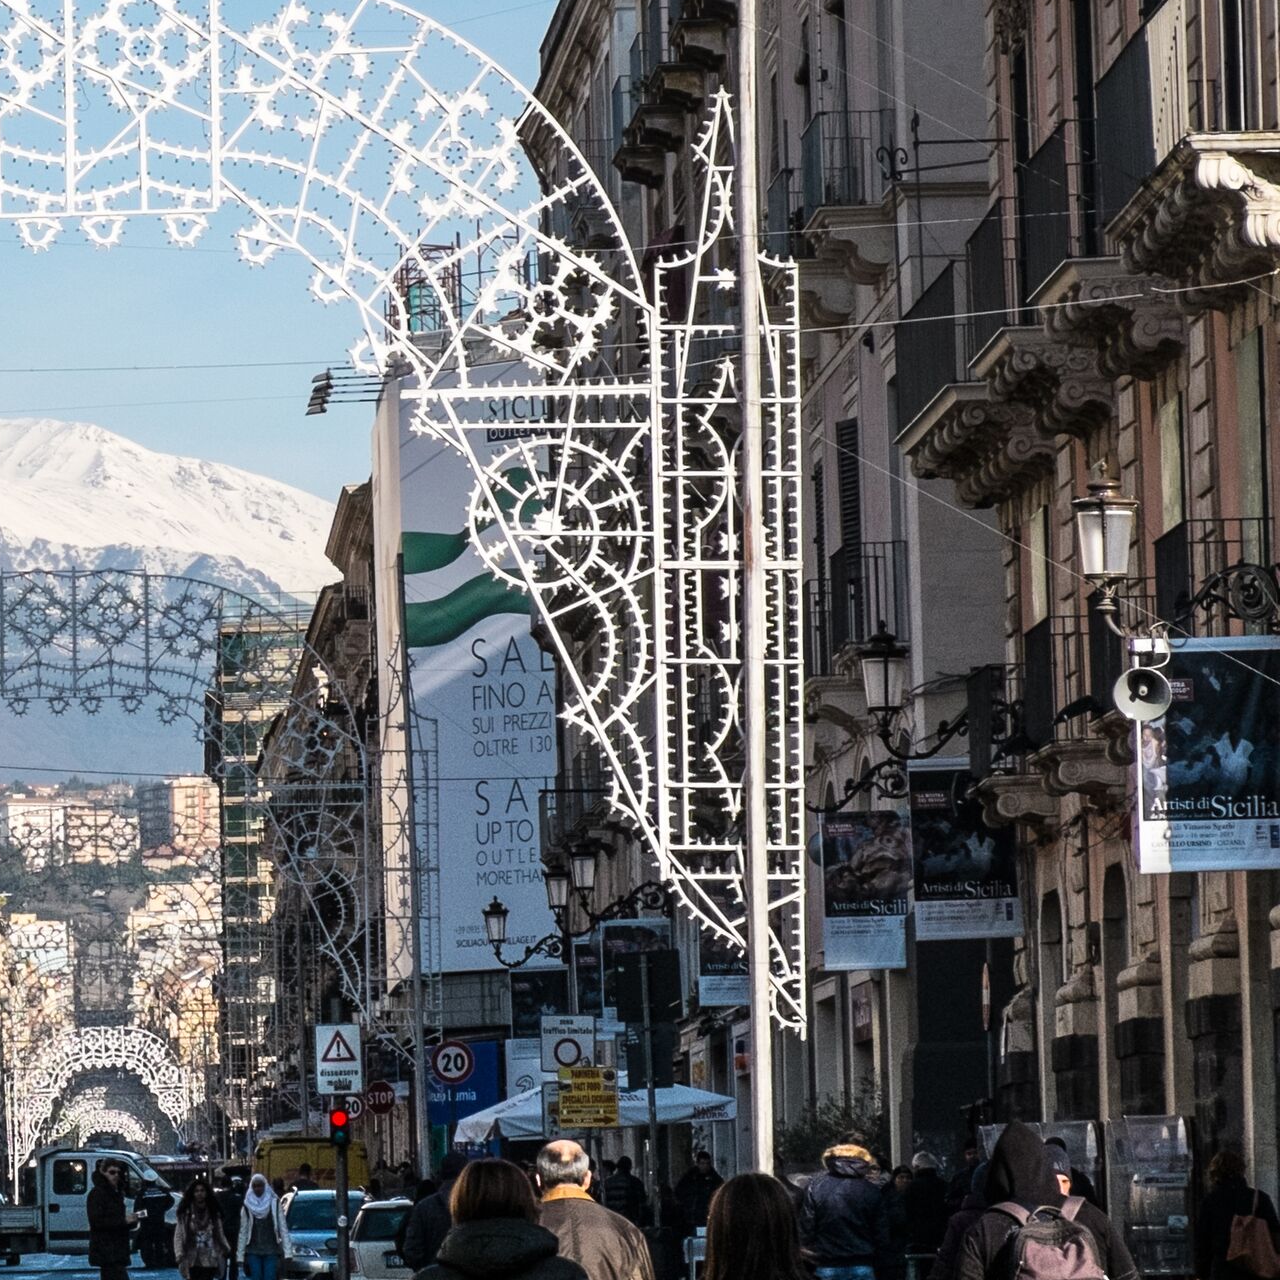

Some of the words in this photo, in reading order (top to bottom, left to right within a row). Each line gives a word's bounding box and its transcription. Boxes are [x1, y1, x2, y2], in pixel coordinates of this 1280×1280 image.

[472, 682, 525, 711] FINO
[536, 680, 553, 705] A
[472, 717, 494, 735] SUI
[503, 711, 552, 732] PREZZI
[473, 738, 518, 757] OLTRE
[530, 735, 552, 753] 130
[1150, 797, 1195, 811] Artisti
[1197, 796, 1210, 810] di
[1211, 795, 1279, 818] Sicilia
[476, 821, 502, 845] UP
[505, 819, 534, 843] TO
[965, 881, 1014, 898] Sicilia
[543, 1027, 567, 1035] traffico
[567, 1027, 593, 1035] limitato
[320, 1068, 359, 1077] dissuasore
[441, 1053, 466, 1073] 20
[367, 1091, 394, 1105] STOP
